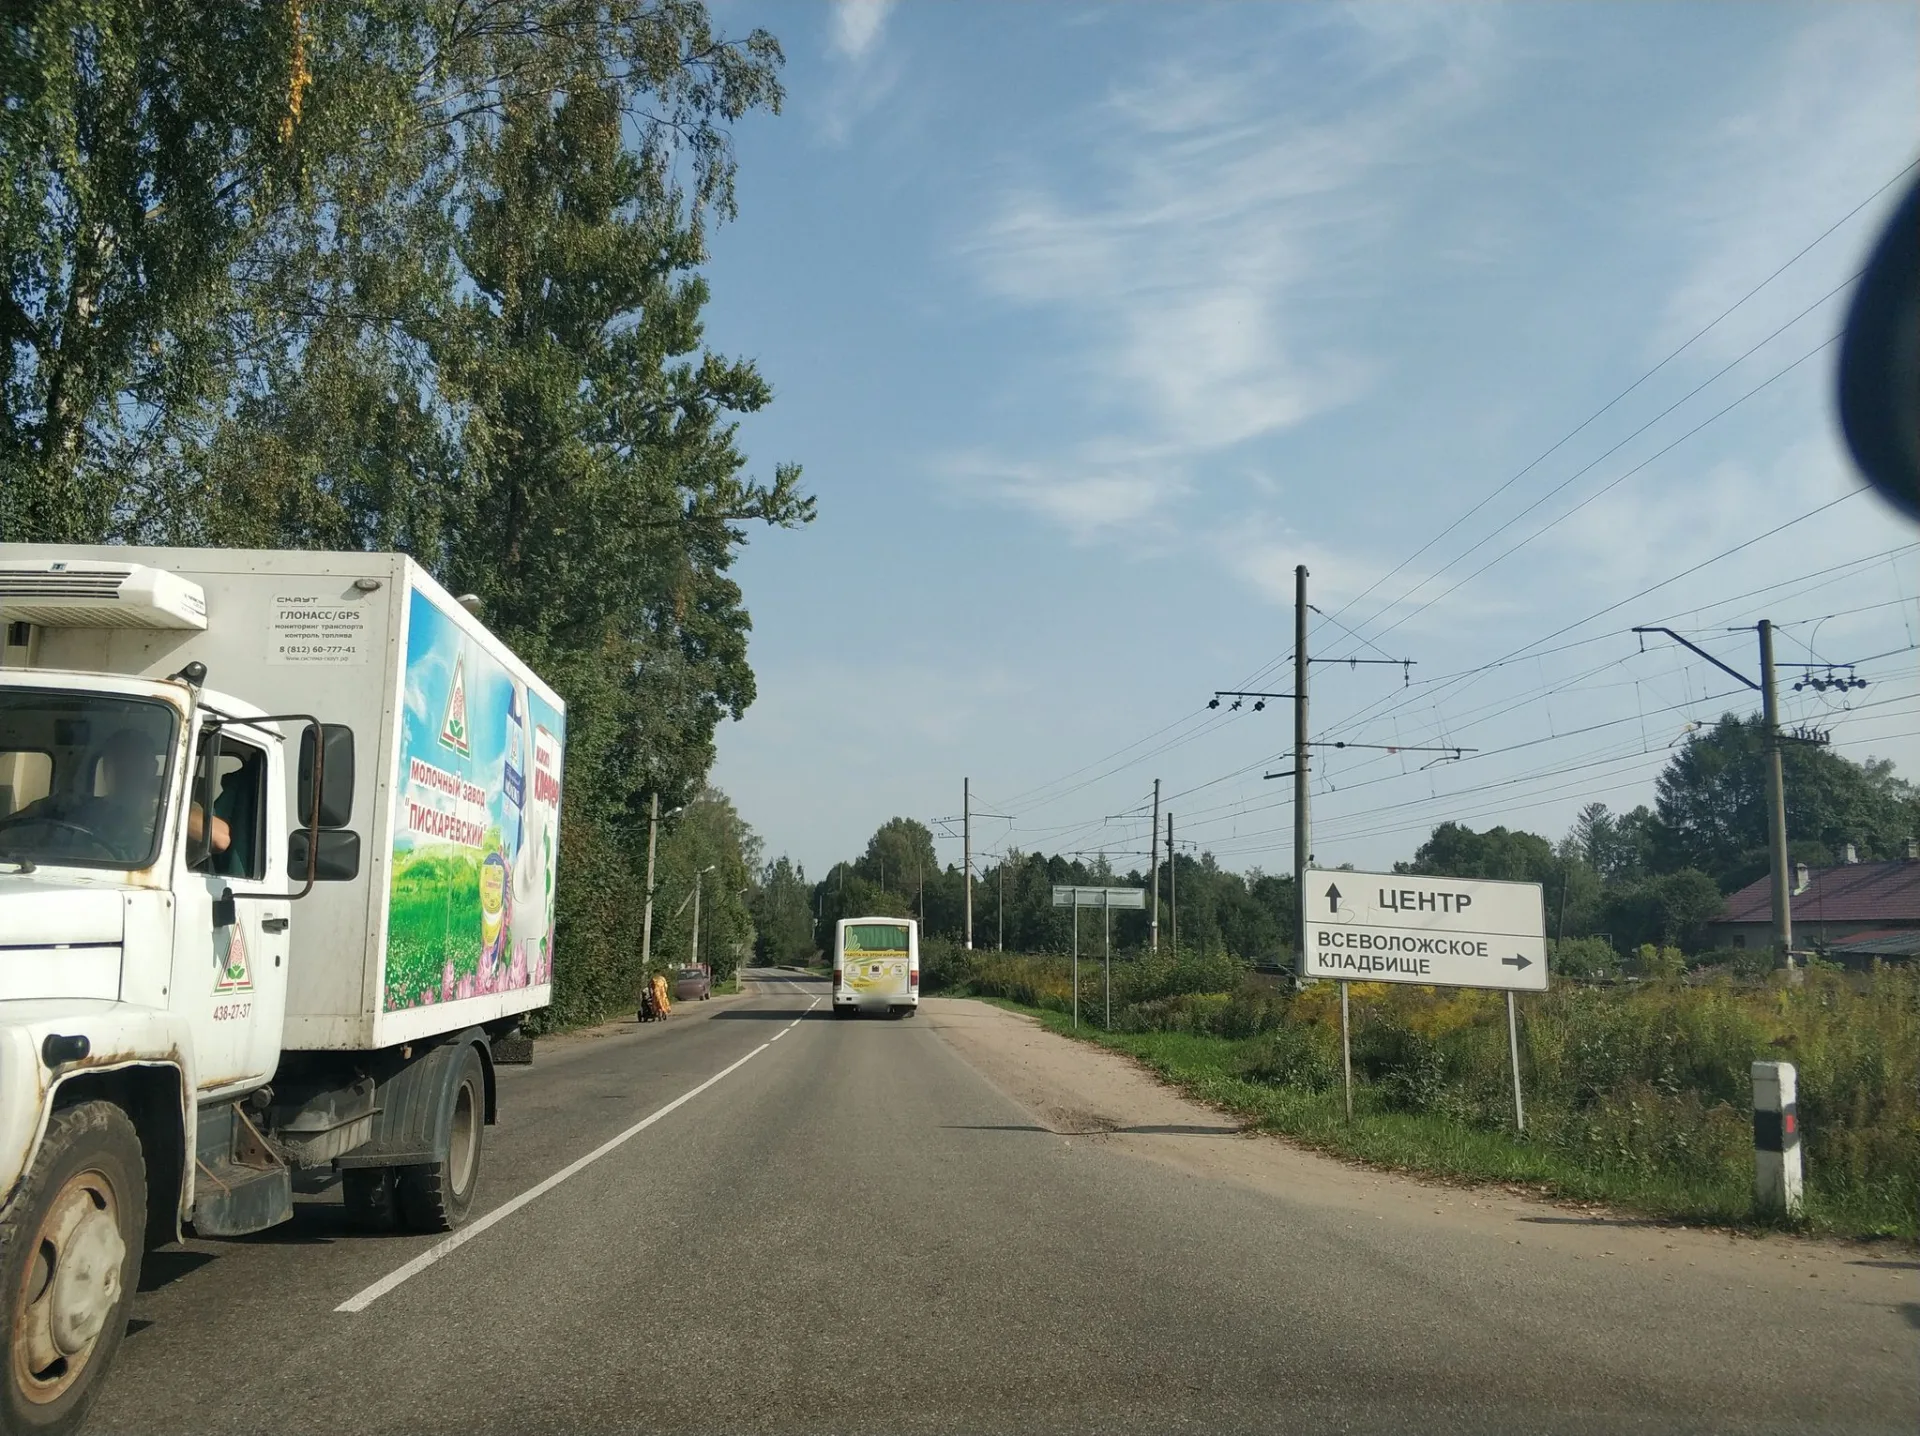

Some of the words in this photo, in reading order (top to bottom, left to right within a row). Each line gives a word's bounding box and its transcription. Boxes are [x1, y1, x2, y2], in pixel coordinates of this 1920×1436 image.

[280, 611, 360, 621] ГЛОНАСС/GPS
[287, 646, 310, 654] (812)
[1379, 888, 1472, 913] ЦЕНТР
[1318, 931, 1489, 957] ВСЕВОЛОЖСКОЕ
[1318, 952, 1431, 976] КЛАДБИЩЕ
[213, 1003, 251, 1021] 438-27-37
